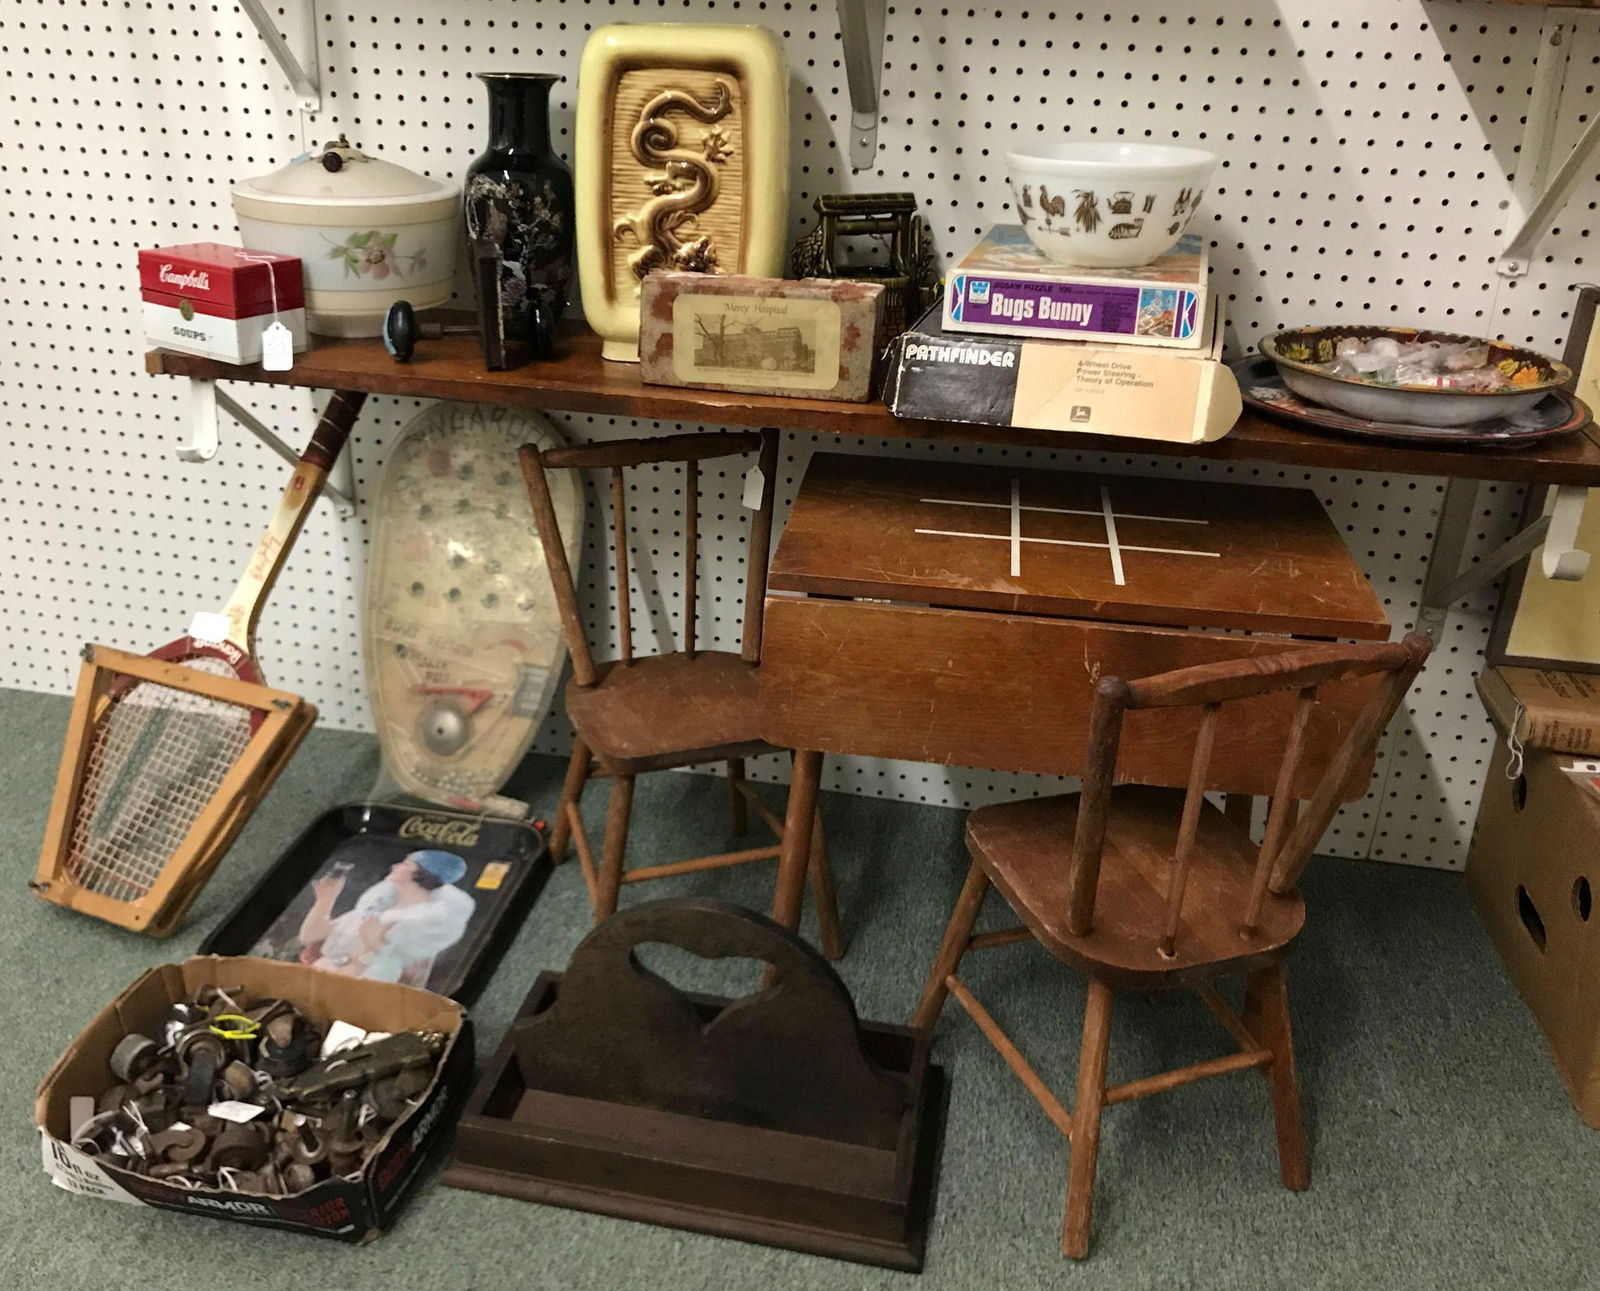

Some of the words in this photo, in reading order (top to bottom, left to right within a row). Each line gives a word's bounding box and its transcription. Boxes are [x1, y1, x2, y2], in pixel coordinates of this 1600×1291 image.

[1024, 284, 1053, 293] PUZZLE
[723, 302, 750, 316] Mercy
[754, 303, 789, 318] Hospital
[990, 292, 1035, 322] Bugs
[1037, 295, 1094, 327] Bunny
[172, 325, 207, 342] SOUPS
[905, 343, 1016, 369] PATHFINDER
[1077, 359, 1109, 369] 4-Wheel
[1111, 361, 1132, 370] Drive
[1075, 367, 1102, 376] Power
[1103, 369, 1137, 380] Steering
[1075, 375, 1103, 385] Theory
[1104, 377, 1113, 385] of
[1114, 378, 1155, 389] Operation
[187, 1195, 271, 1216] ARMOR
